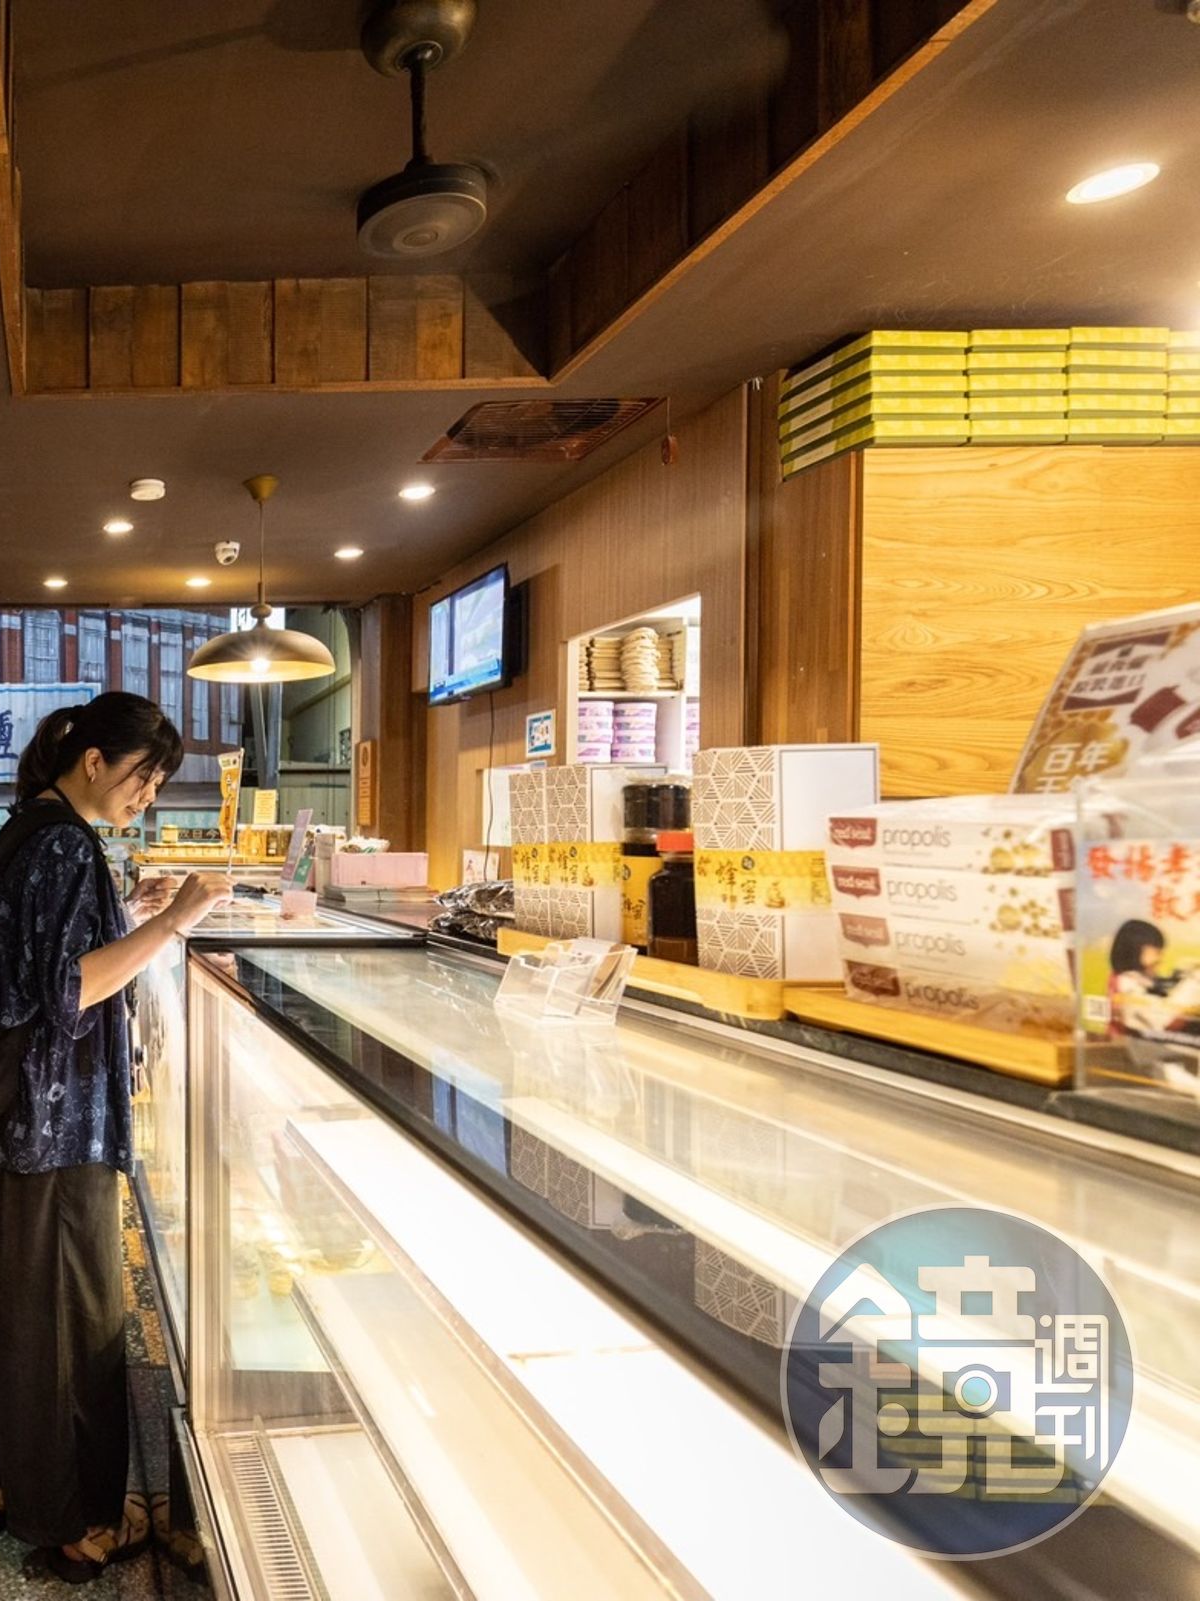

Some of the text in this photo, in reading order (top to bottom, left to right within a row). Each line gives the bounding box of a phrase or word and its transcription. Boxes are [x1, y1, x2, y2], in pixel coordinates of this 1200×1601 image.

[883, 826, 951, 847] propolis
[887, 879, 957, 902] propolis
[895, 931, 966, 956] propolis
